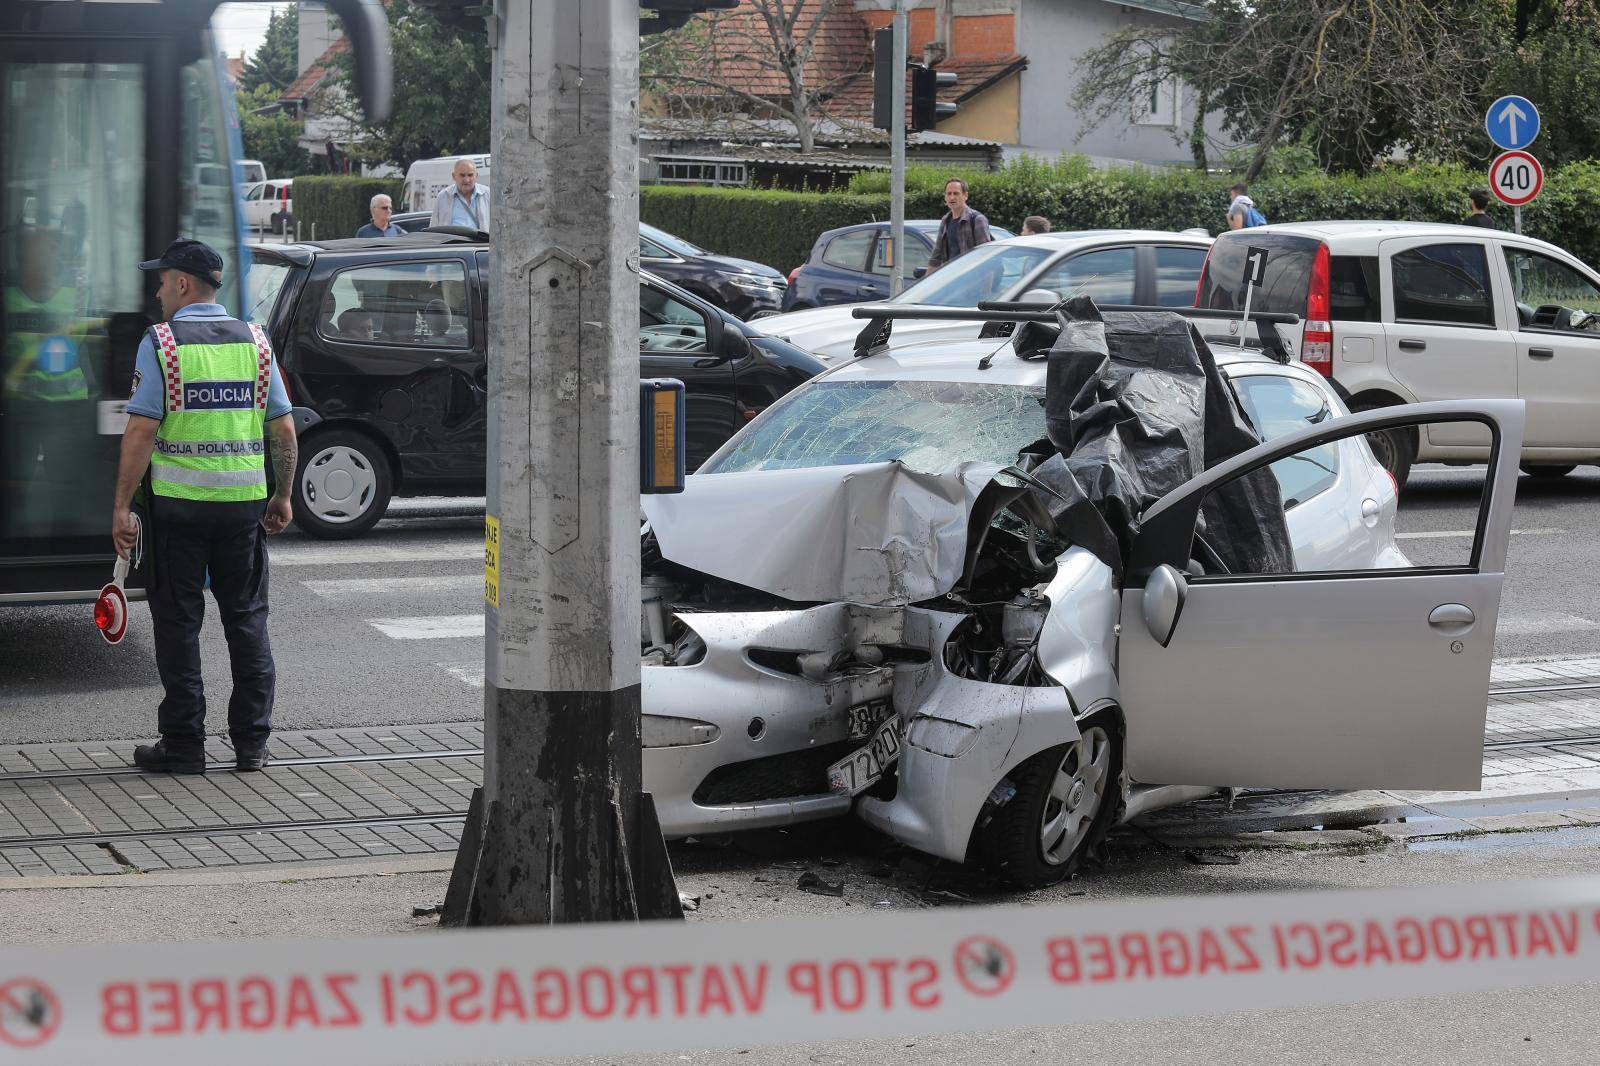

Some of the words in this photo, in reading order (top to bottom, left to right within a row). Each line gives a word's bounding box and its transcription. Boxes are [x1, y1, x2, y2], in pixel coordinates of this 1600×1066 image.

[1501, 165, 1530, 190] 40
[1249, 253, 1261, 280] 1
[187, 387, 252, 403] POLICIJA
[197, 443, 245, 454] POLICIJA
